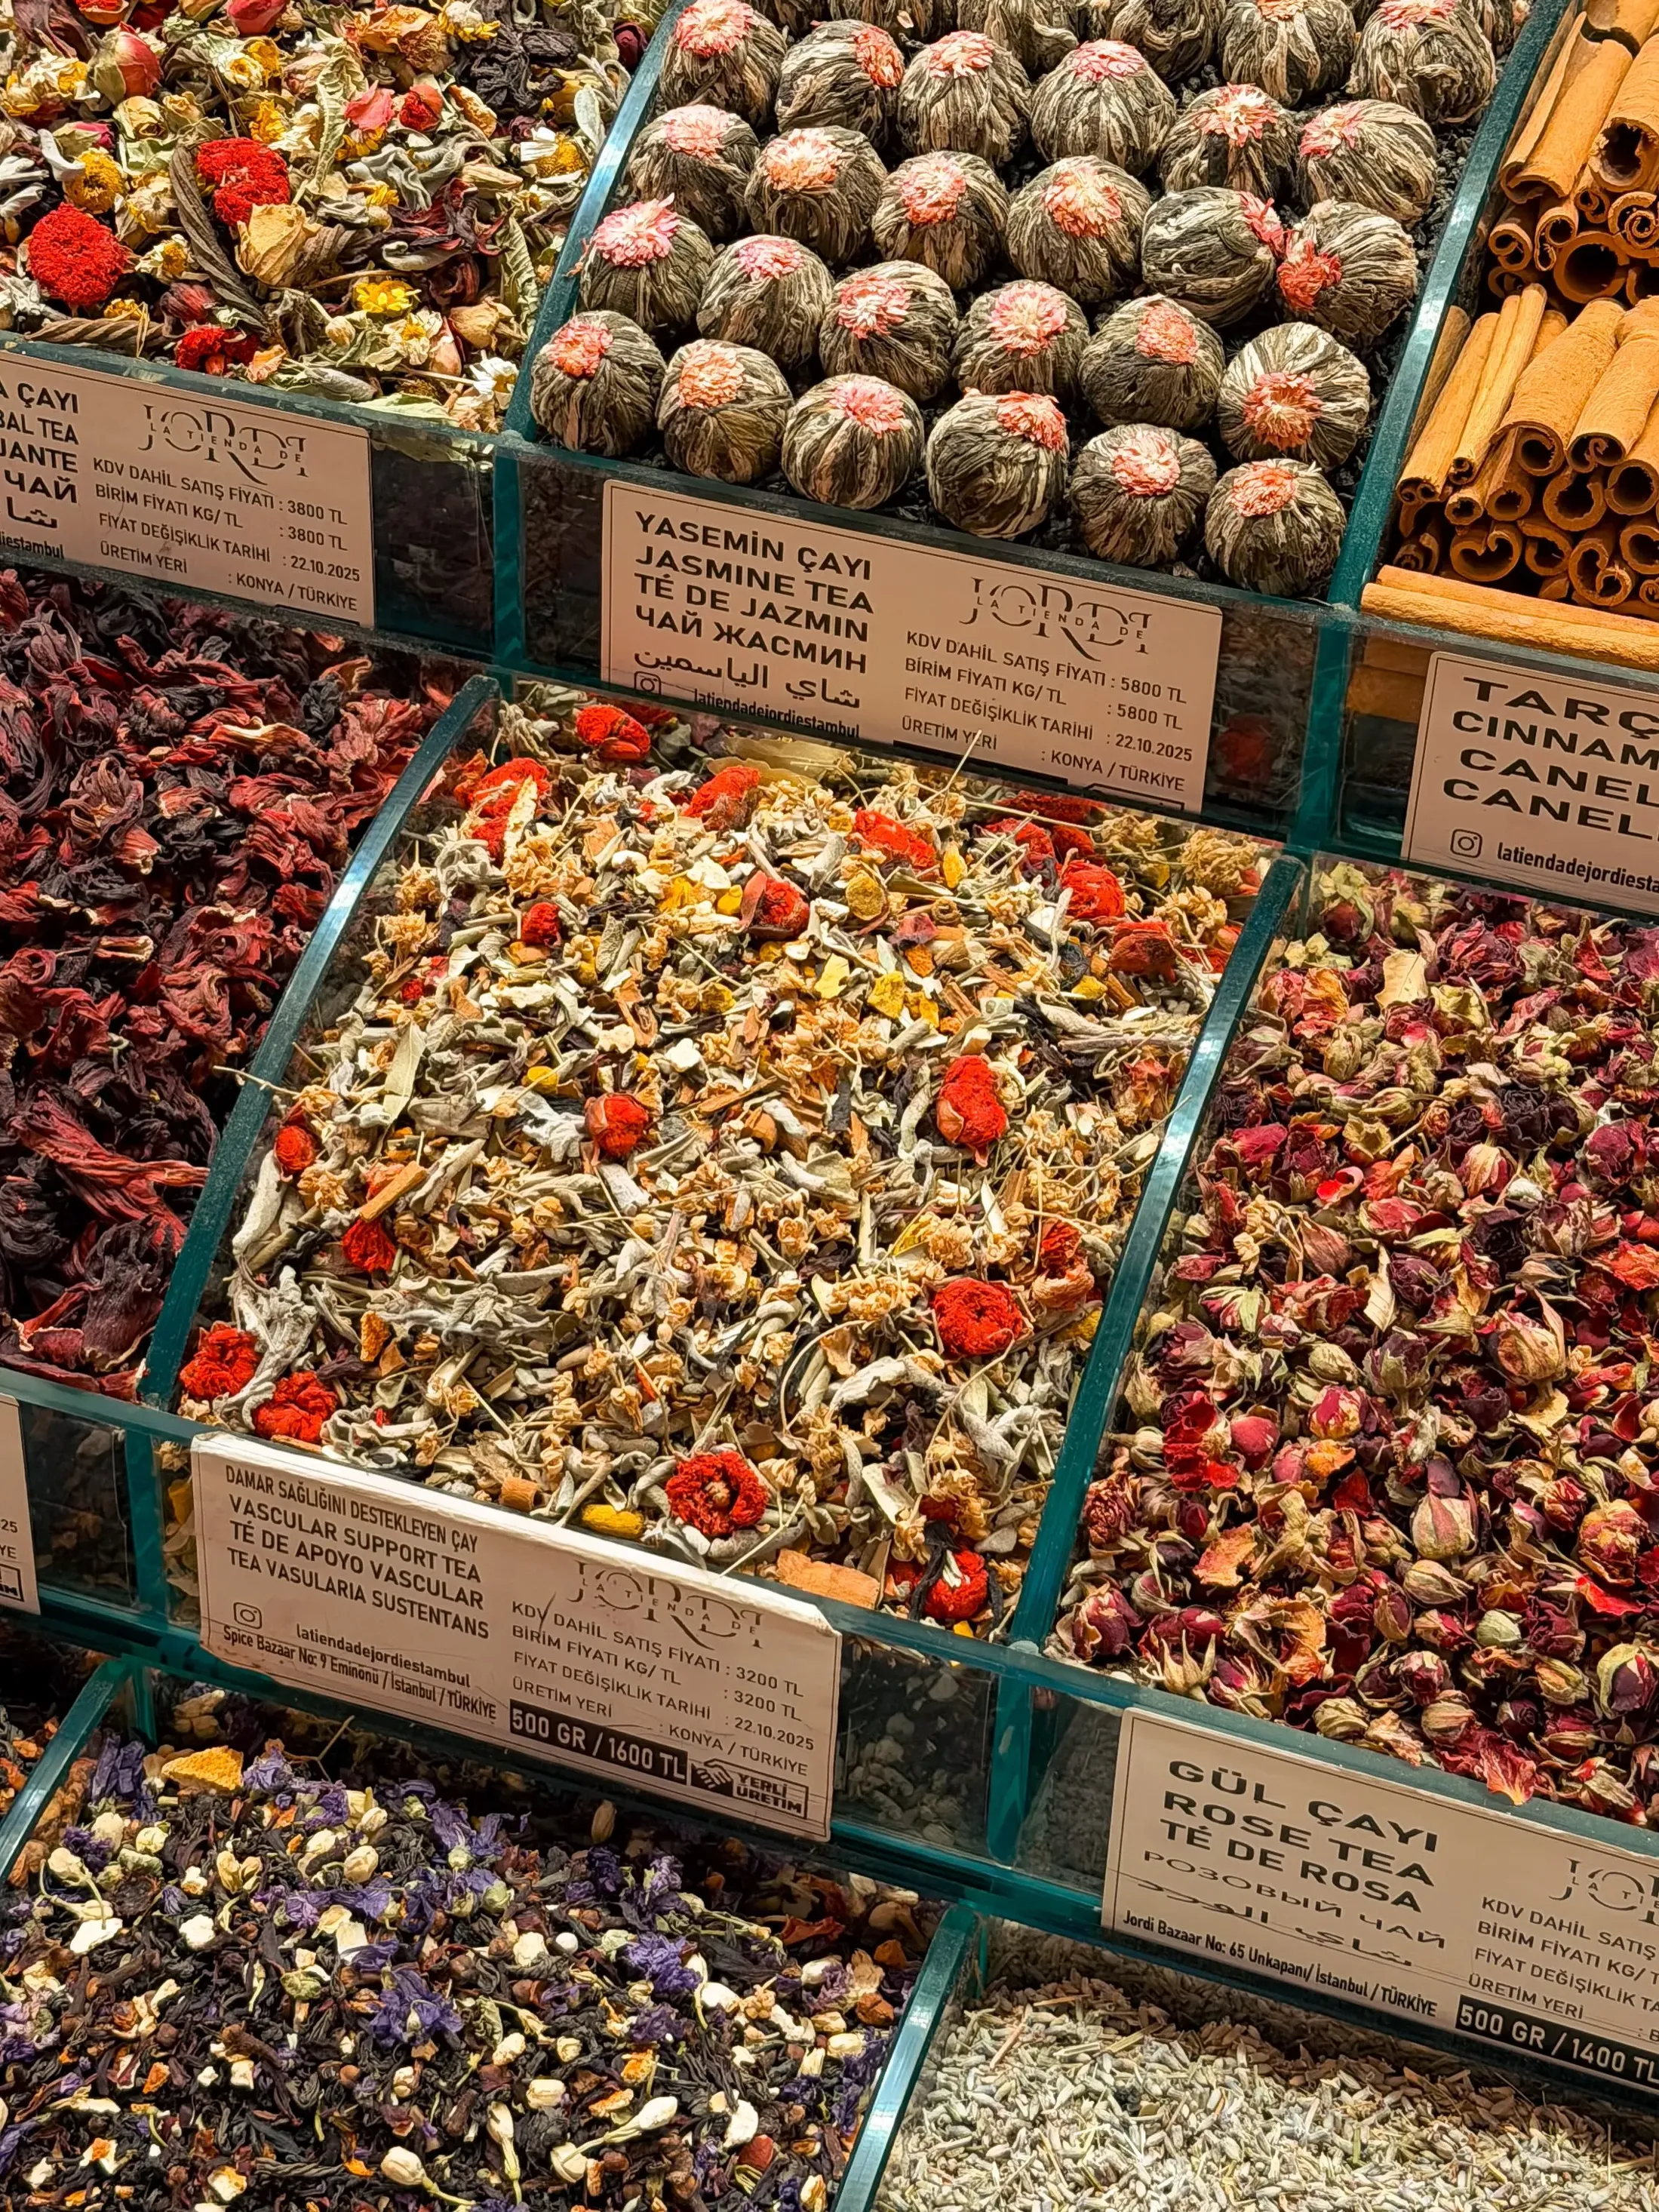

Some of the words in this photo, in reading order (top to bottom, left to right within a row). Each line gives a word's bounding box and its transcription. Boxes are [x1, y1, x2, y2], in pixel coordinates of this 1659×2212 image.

[17, 382, 79, 413] ÇAYI
[38, 419, 79, 445] TEA
[5, 470, 78, 503] ЧАЙ
[93, 458, 124, 476] KDV
[130, 465, 177, 488] DAHİL
[181, 478, 224, 501] SATIŞ
[229, 485, 274, 509] FİYATI
[287, 500, 324, 520] 3800
[330, 508, 348, 524] TL
[97, 484, 138, 505] BİRİM
[143, 493, 188, 516] FİYATI
[226, 512, 243, 528] TL
[288, 527, 324, 545] 3800
[330, 535, 348, 551] TL
[0, 530, 65, 559] iestambul
[100, 513, 137, 533] FİYAT
[141, 520, 220, 550] DEĞİŞİKLİK
[225, 540, 270, 562] TARİHİ
[290, 555, 360, 582] 22.10.2025
[100, 541, 152, 566] ÜRETİM
[155, 555, 187, 573] YERİ
[237, 573, 284, 598] KONYA
[299, 586, 358, 611] TÜRKİYE
[634, 511, 784, 561] YASEMİN
[797, 547, 871, 580] ÇAYI
[634, 573, 674, 600] TÉ
[687, 585, 730, 612] DE
[740, 598, 868, 641] JAZMIN
[636, 546, 795, 597] JASMINE
[805, 580, 874, 614] TEA
[634, 651, 768, 689] الياسمين
[636, 605, 702, 638] ЧАЙ
[712, 622, 866, 674] ЖАСМИН
[907, 631, 940, 650] KDV
[946, 639, 997, 662] DAHİL
[1003, 652, 1049, 676] SATIŞ
[1056, 663, 1106, 686] FİYATI
[1120, 677, 1161, 698] 5800
[1167, 687, 1187, 704] TL
[785, 679, 860, 709] شاي
[905, 657, 951, 680] BİRİM
[957, 668, 1006, 691] FİYATI
[1047, 690, 1066, 705] TL
[1117, 703, 1157, 724] 5800
[1163, 714, 1183, 730] TL
[905, 687, 946, 708] FİYAT
[951, 697, 1037, 729] DEĞİŞİKLİK
[1041, 717, 1093, 741] TARİHİ
[1115, 733, 1192, 762] 22.10.2025
[902, 716, 957, 741] ÜRETİM
[963, 729, 997, 750] YERİ
[1051, 750, 1103, 774] KONYA
[1120, 765, 1185, 792] TÜRKİYE
[1443, 779, 1659, 843] CANEL
[226, 1465, 275, 1496] DAMAR
[278, 1481, 346, 1516] SAĞLIĞINI
[350, 1501, 446, 1544] DESTEKLEYEN
[452, 1530, 478, 1553] ÇAY
[229, 1495, 337, 1541] VASCULAR
[344, 1527, 438, 1570] SUPPORT
[442, 1556, 481, 1583] TEA
[227, 1547, 261, 1574] TEA
[266, 1558, 366, 1604] VASULARIA
[373, 1590, 489, 1639] SUSTENTANS
[230, 1520, 254, 1544] TÉ
[263, 1531, 288, 1554] DE
[296, 1541, 363, 1575] APOYO
[370, 1560, 483, 1610] VASCULAR
[224, 1625, 253, 1647] Spice
[257, 1635, 295, 1660] Bazaar
[321, 1653, 327, 1669] 9
[447, 1688, 496, 1719] TÜRKİYE
[296, 1624, 470, 1688] latiendadejordiestambul
[512, 1601, 546, 1622] KDV
[555, 1613, 607, 1639] DAHİL
[613, 1631, 662, 1657] SATIŞ
[668, 1645, 720, 1673] FİYATI
[736, 1667, 778, 1690] 3200
[784, 1680, 804, 1697] TL
[513, 1625, 561, 1649] BİRİM
[567, 1640, 619, 1667] FİYATI
[661, 1669, 681, 1685] TL
[734, 1691, 776, 1713] 3200
[782, 1704, 802, 1721] TL
[513, 1676, 571, 1705] ÜRETİM
[576, 1697, 612, 1718] YERİ
[669, 1725, 724, 1750] KONYA
[740, 1745, 808, 1777] TÜRKİYE
[514, 1651, 557, 1673] FİYAT
[562, 1664, 652, 1704] DEĞİŞİKLİK
[659, 1694, 711, 1720] TARİHİ
[735, 1717, 814, 1750] 22.10.2025
[512, 1710, 549, 1738] 500
[558, 1723, 585, 1750] GR
[609, 1737, 653, 1770] 1600
[660, 1753, 685, 1780] TL
[1164, 1790, 1312, 1850] ROSE
[1329, 1839, 1434, 1887] TEA
[1169, 1760, 1286, 1809] GÜL
[1307, 1800, 1437, 1852] ÇAYI
[1144, 1851, 1342, 1918] РОЗОВЫЙ
[1359, 1914, 1445, 1949] ЧАЙ
[1160, 1819, 1212, 1851] TÉ
[1227, 1839, 1284, 1872] DE
[1300, 1860, 1421, 1913] ROSA
[1123, 1910, 1154, 1932] Jordi
[1157, 1919, 1203, 1946] Bazaar
[1229, 1941, 1245, 1959] 65
[1381, 1986, 1437, 2017] TÜRKİYE
[1477, 1921, 1534, 1948] BİRİM
[1541, 1940, 1600, 1968] FİYATI
[1482, 1897, 1524, 1919] KDV
[1529, 1911, 1590, 1940] DAHİL
[1598, 1931, 1656, 1961] SATIŞ
[1469, 1973, 1536, 2005] ÜRETİM
[1542, 1995, 1584, 2020] YERİ
[1475, 1947, 1525, 1972] FİYAT
[1530, 1964, 1636, 2008] DEĞİŞİKLİK
[1459, 2004, 1503, 2035] 500
[1512, 2021, 1546, 2049] GR
[1572, 2038, 1626, 2073] 1400
[1634, 2057, 1659, 2083] TL
